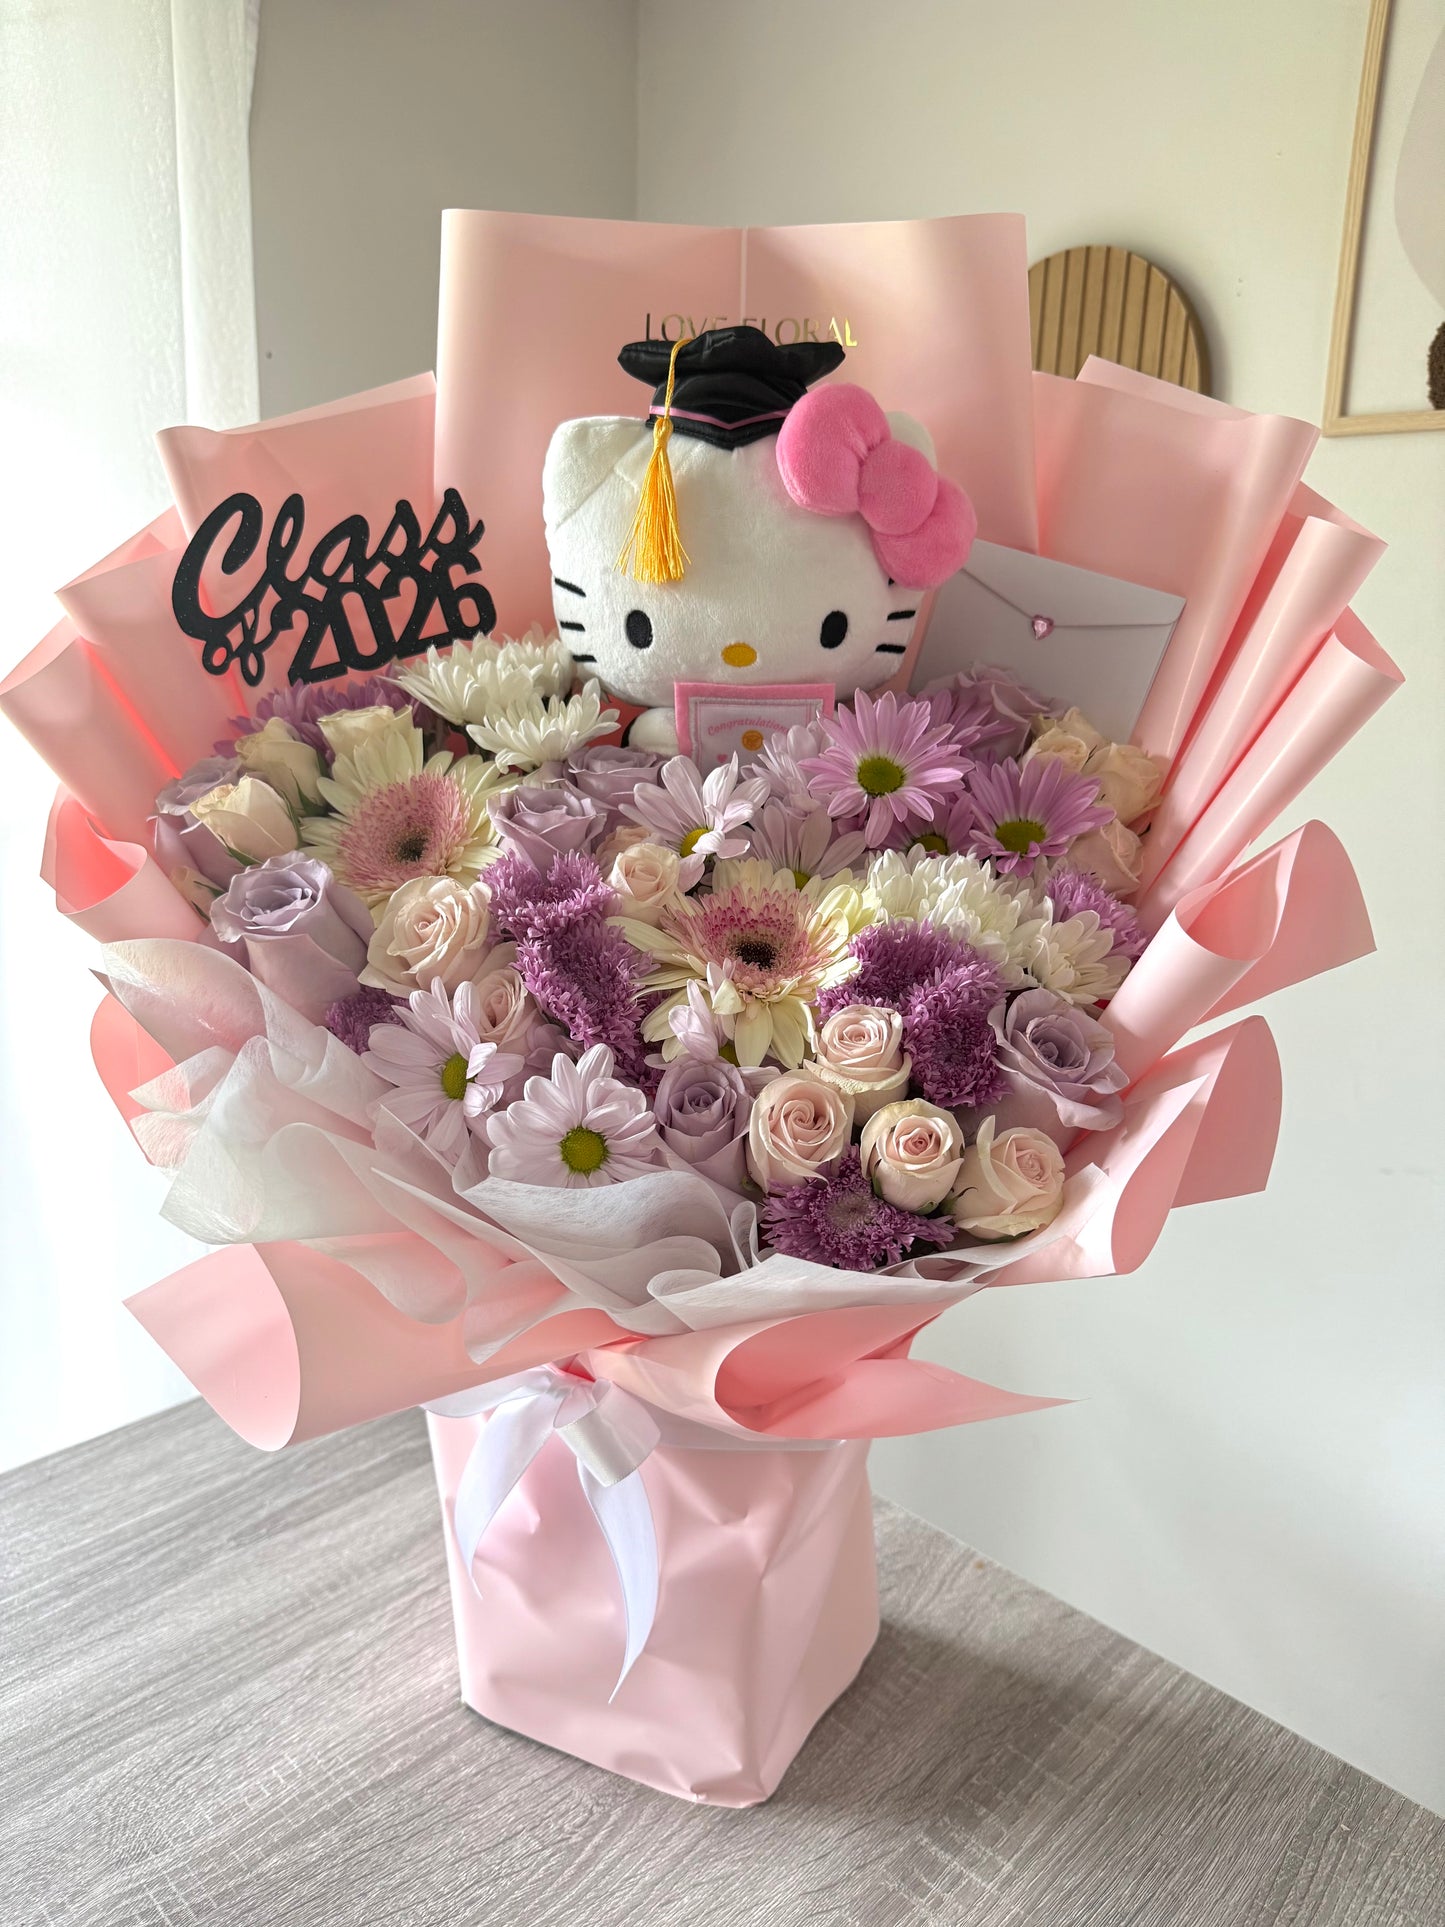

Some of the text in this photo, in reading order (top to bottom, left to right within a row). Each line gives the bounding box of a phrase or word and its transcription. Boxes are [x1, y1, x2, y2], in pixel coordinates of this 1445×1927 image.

[172, 488, 486, 640] Class
[202, 551, 497, 687] of 2026
